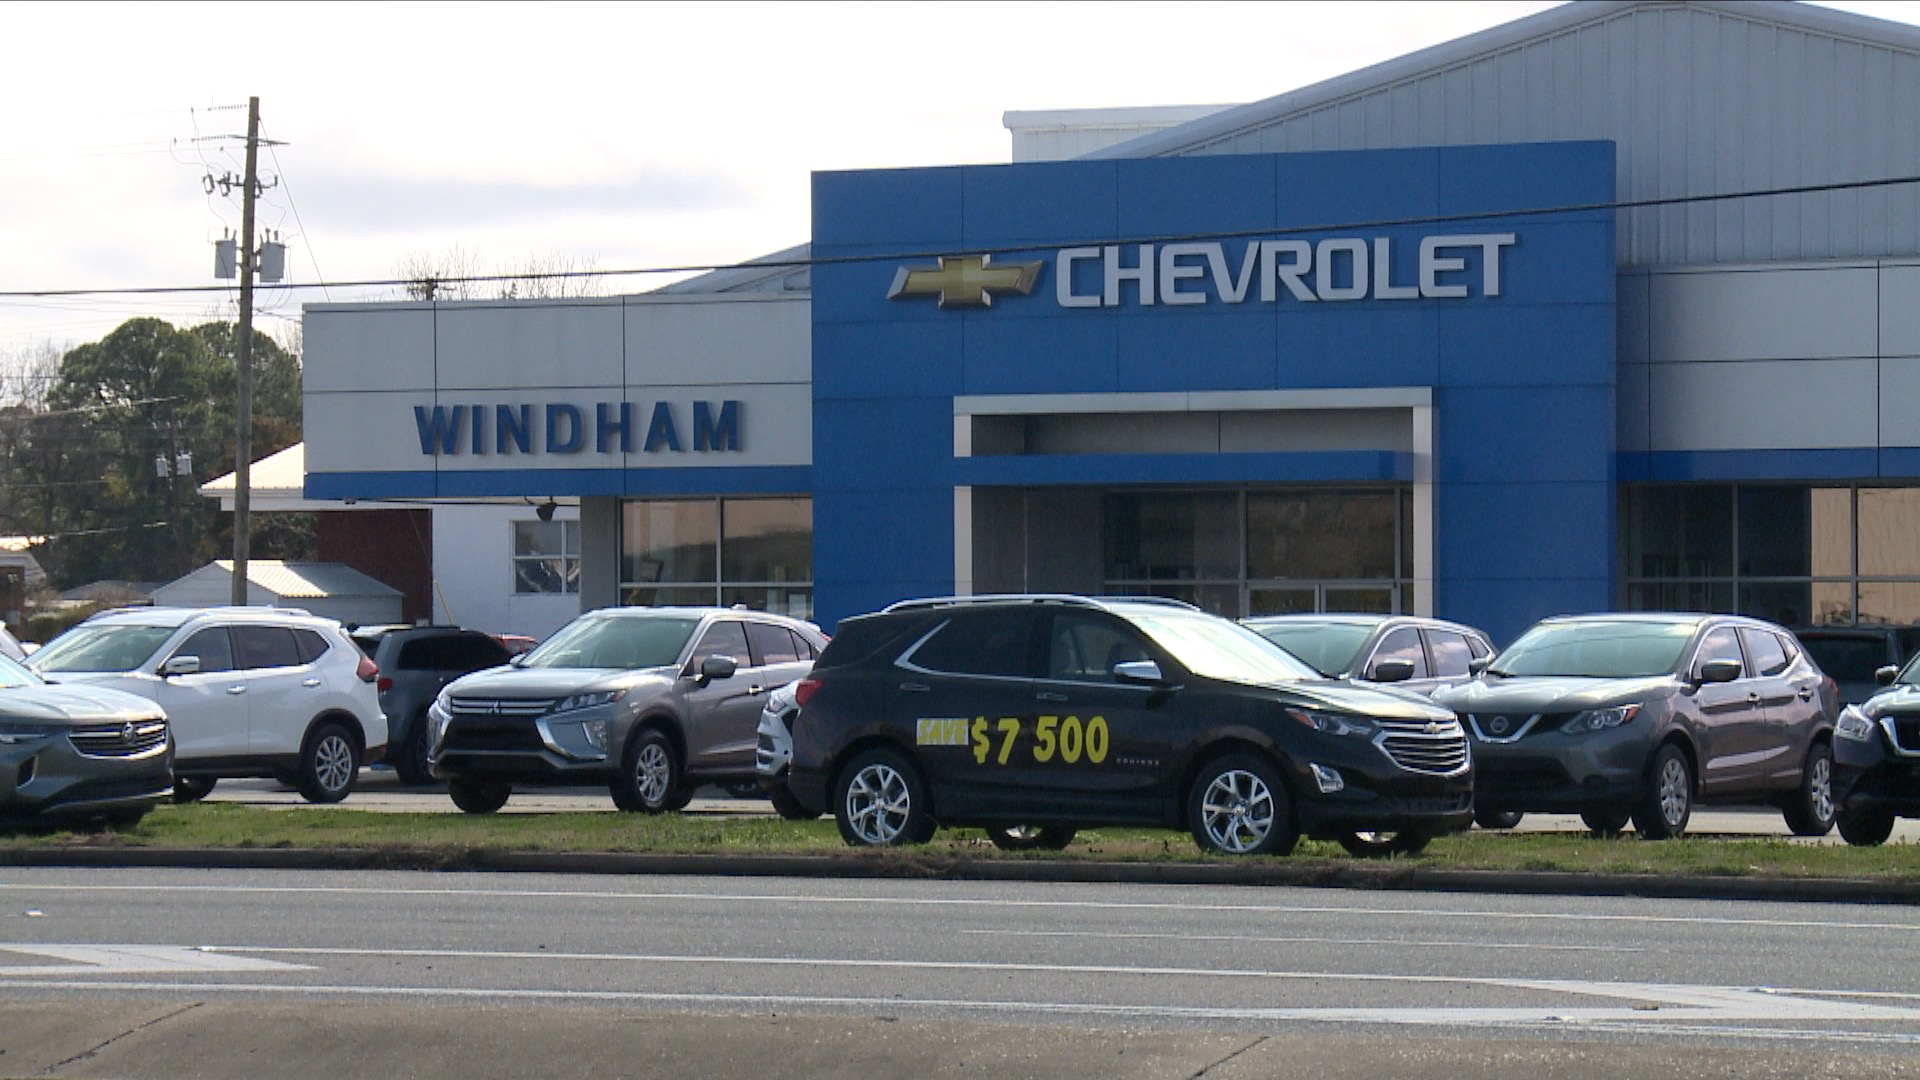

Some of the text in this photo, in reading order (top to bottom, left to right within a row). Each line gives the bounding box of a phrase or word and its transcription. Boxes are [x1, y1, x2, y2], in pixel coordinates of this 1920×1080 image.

[1056, 233, 1516, 308] CHEVROLET
[414, 401, 741, 455] WINDHAM
[917, 719, 967, 745] SAVE
[1033, 716, 1109, 764] 500
